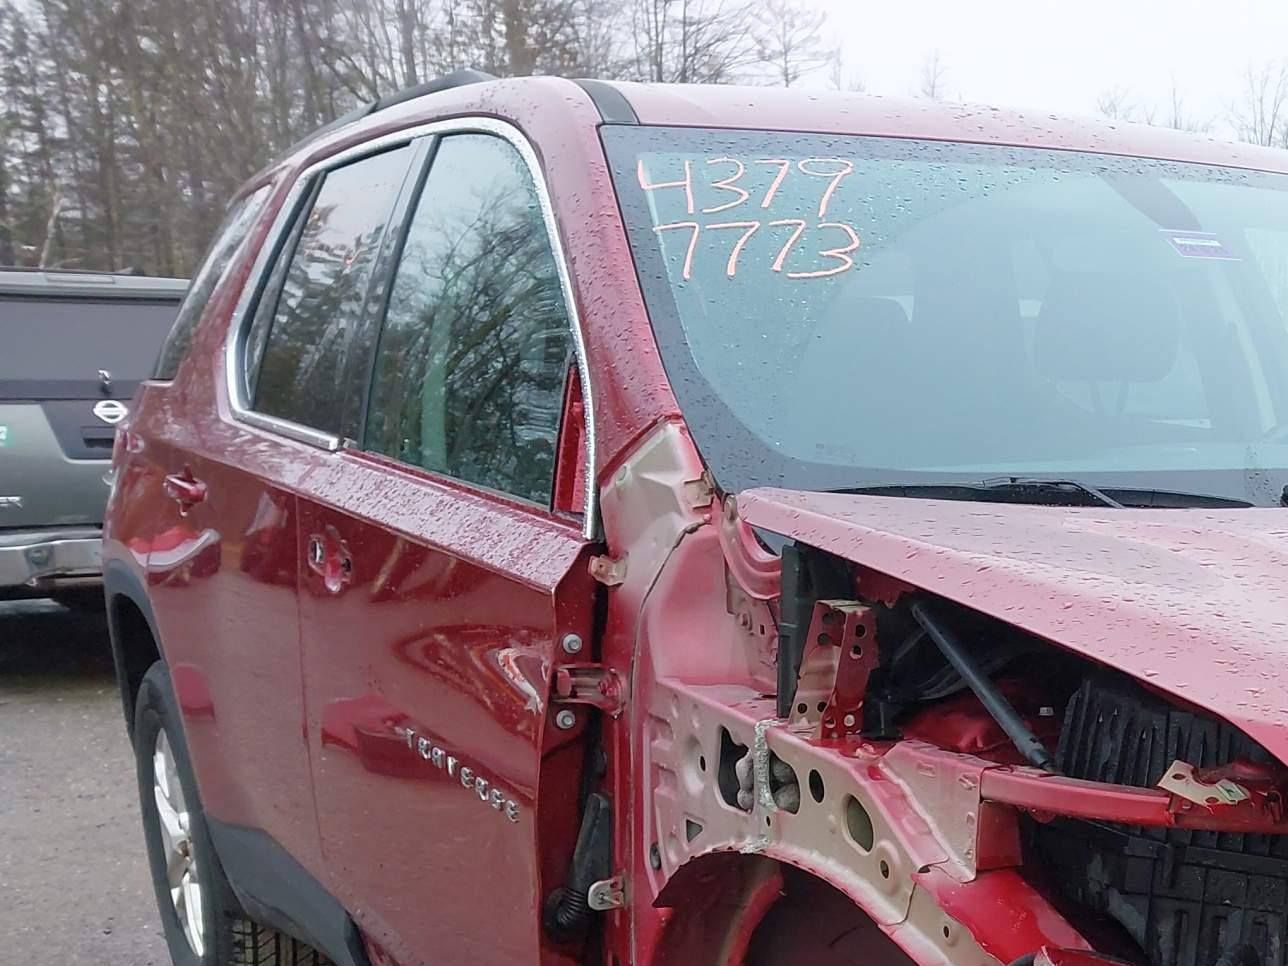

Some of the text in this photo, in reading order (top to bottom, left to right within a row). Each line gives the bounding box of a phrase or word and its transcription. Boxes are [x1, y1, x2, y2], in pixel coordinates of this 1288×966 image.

[637, 156, 854, 217] 4379
[652, 219, 861, 280] 7773
[403, 727, 520, 823] TRAVERSE
